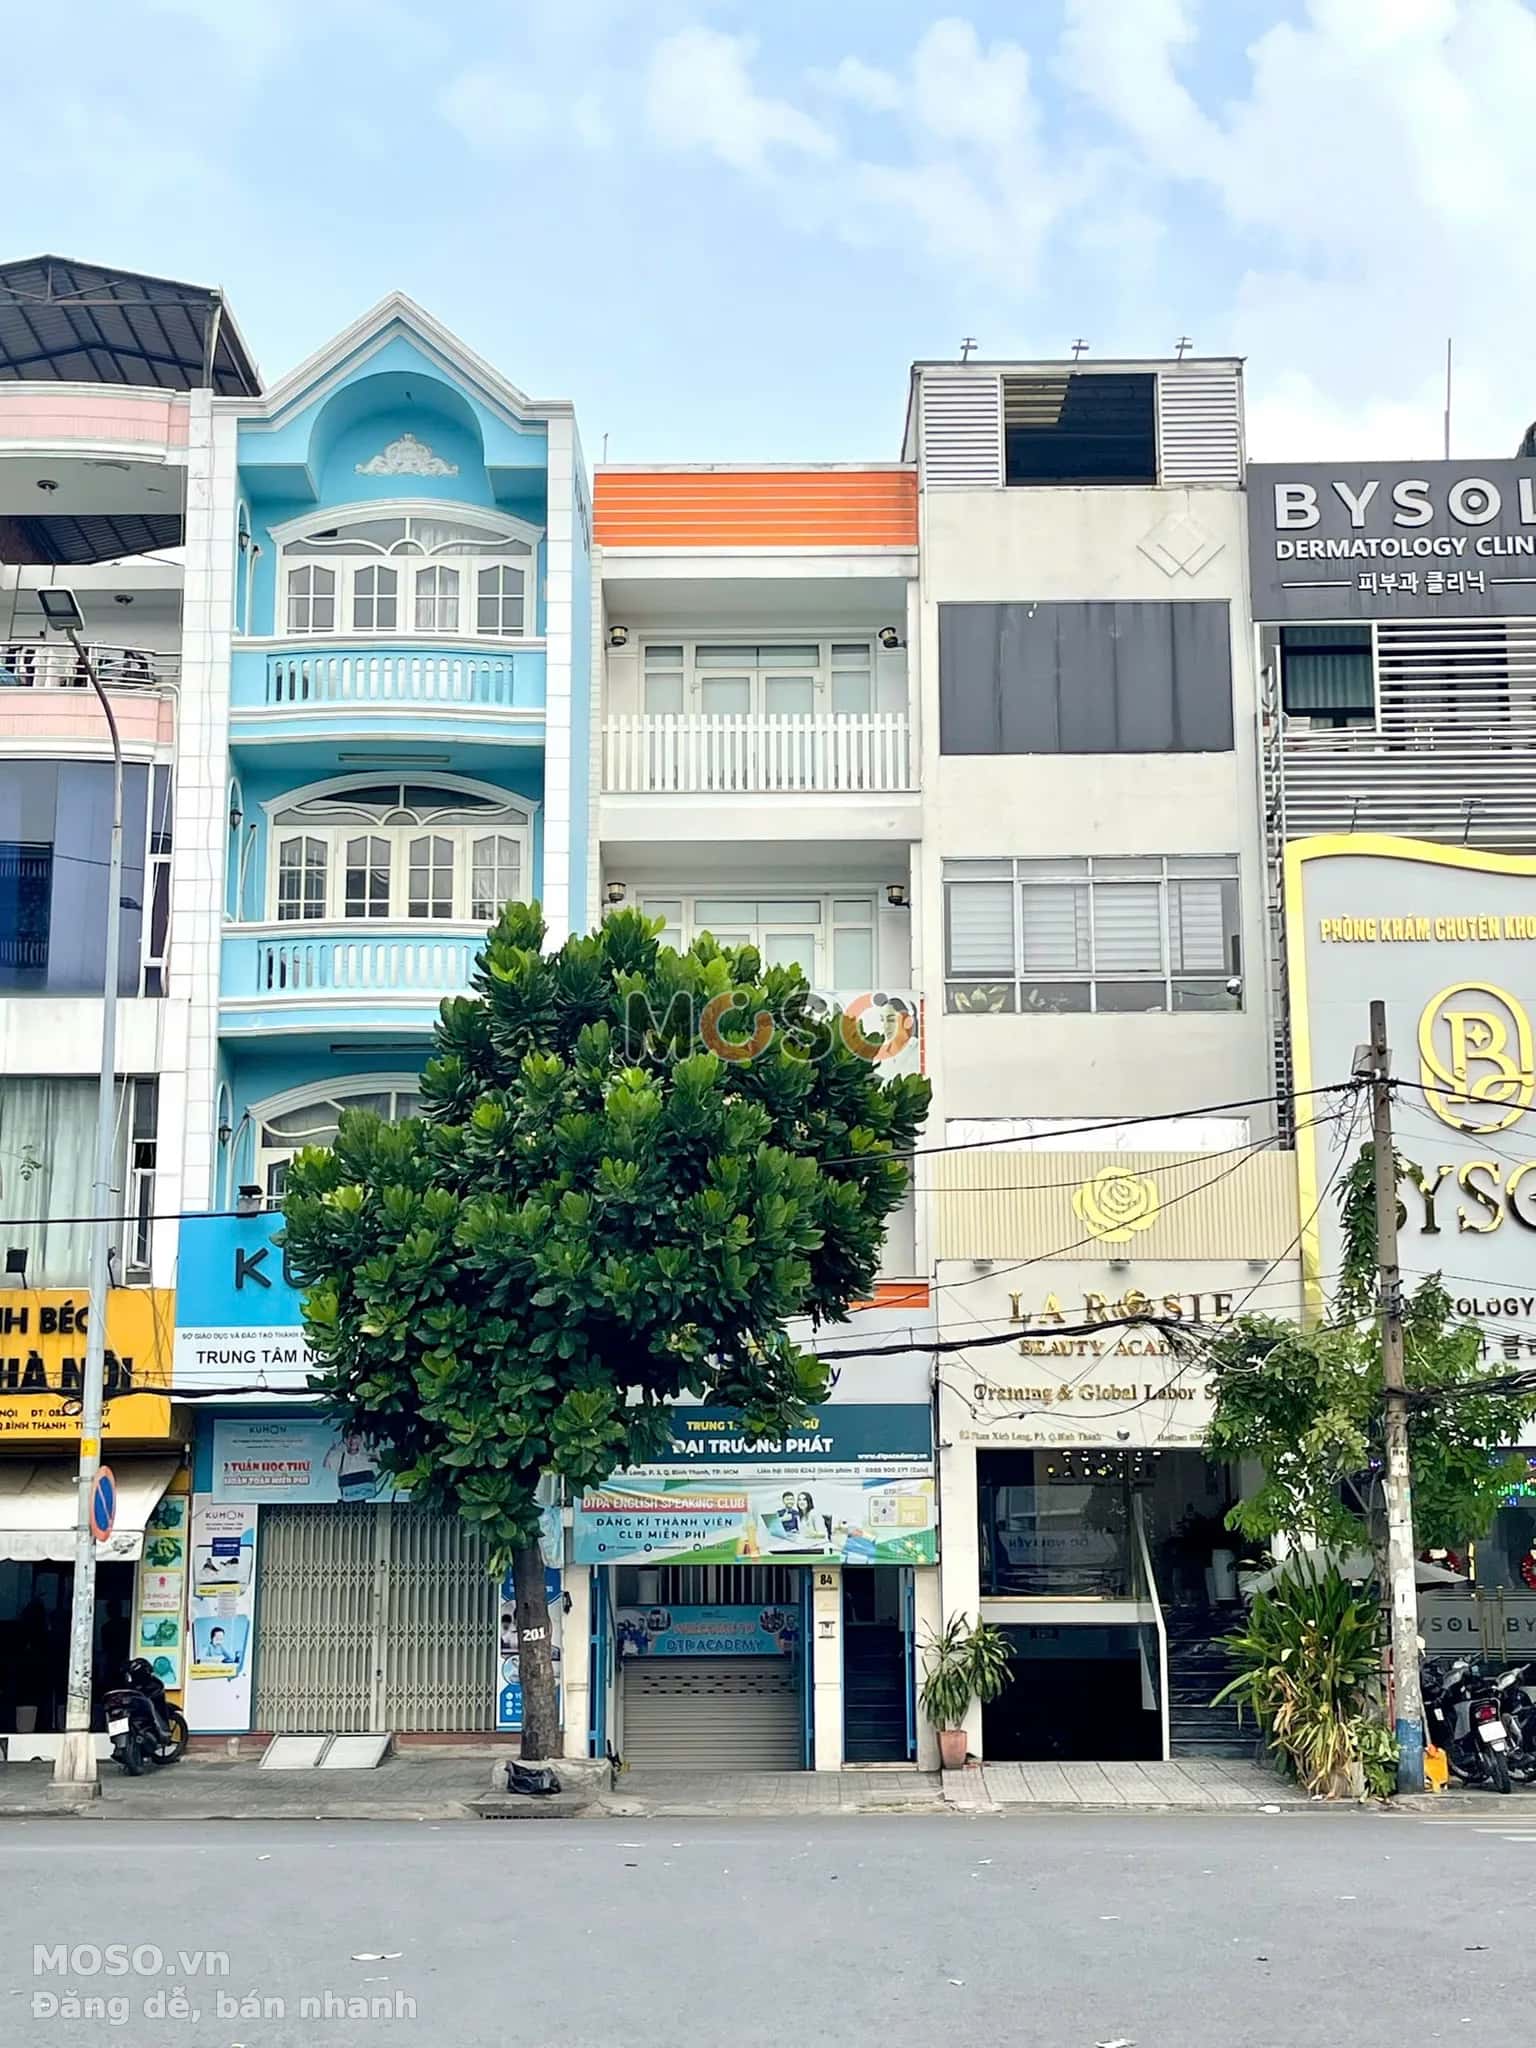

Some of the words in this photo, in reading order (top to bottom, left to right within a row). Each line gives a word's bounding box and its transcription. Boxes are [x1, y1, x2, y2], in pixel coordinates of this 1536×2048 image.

[1273, 478, 1536, 529] BYSOL
[1275, 536, 1468, 560] DERMATOLOGY
[1357, 571, 1419, 595] 피부과
[1425, 570, 1486, 595] 클리닉
[1320, 913, 1377, 942] PHÒNG
[1380, 913, 1431, 942] KHÁM
[1435, 913, 1501, 942] CHUYÊN
[196, 1350, 256, 1364] TRUNG
[262, 1347, 297, 1363] TÂM
[1018, 1340, 1105, 1358] BEAUTY
[974, 1383, 1053, 1406] Training
[1057, 1384, 1073, 1401] &
[1078, 1383, 1137, 1401] Global
[1144, 1384, 1194, 1401] Labor
[686, 1421, 725, 1431] TRUNG
[672, 1439, 704, 1457] ĐẠI
[786, 1434, 833, 1453] PHÁT
[613, 1496, 658, 1510] ENGLISH
[718, 1496, 746, 1510] CLUB
[205, 1510, 245, 1520] KUMON
[655, 1515, 699, 1527] THÀNH
[619, 1530, 642, 1539] CLB
[819, 1573, 833, 1586] 84
[522, 1626, 546, 1642] 201
